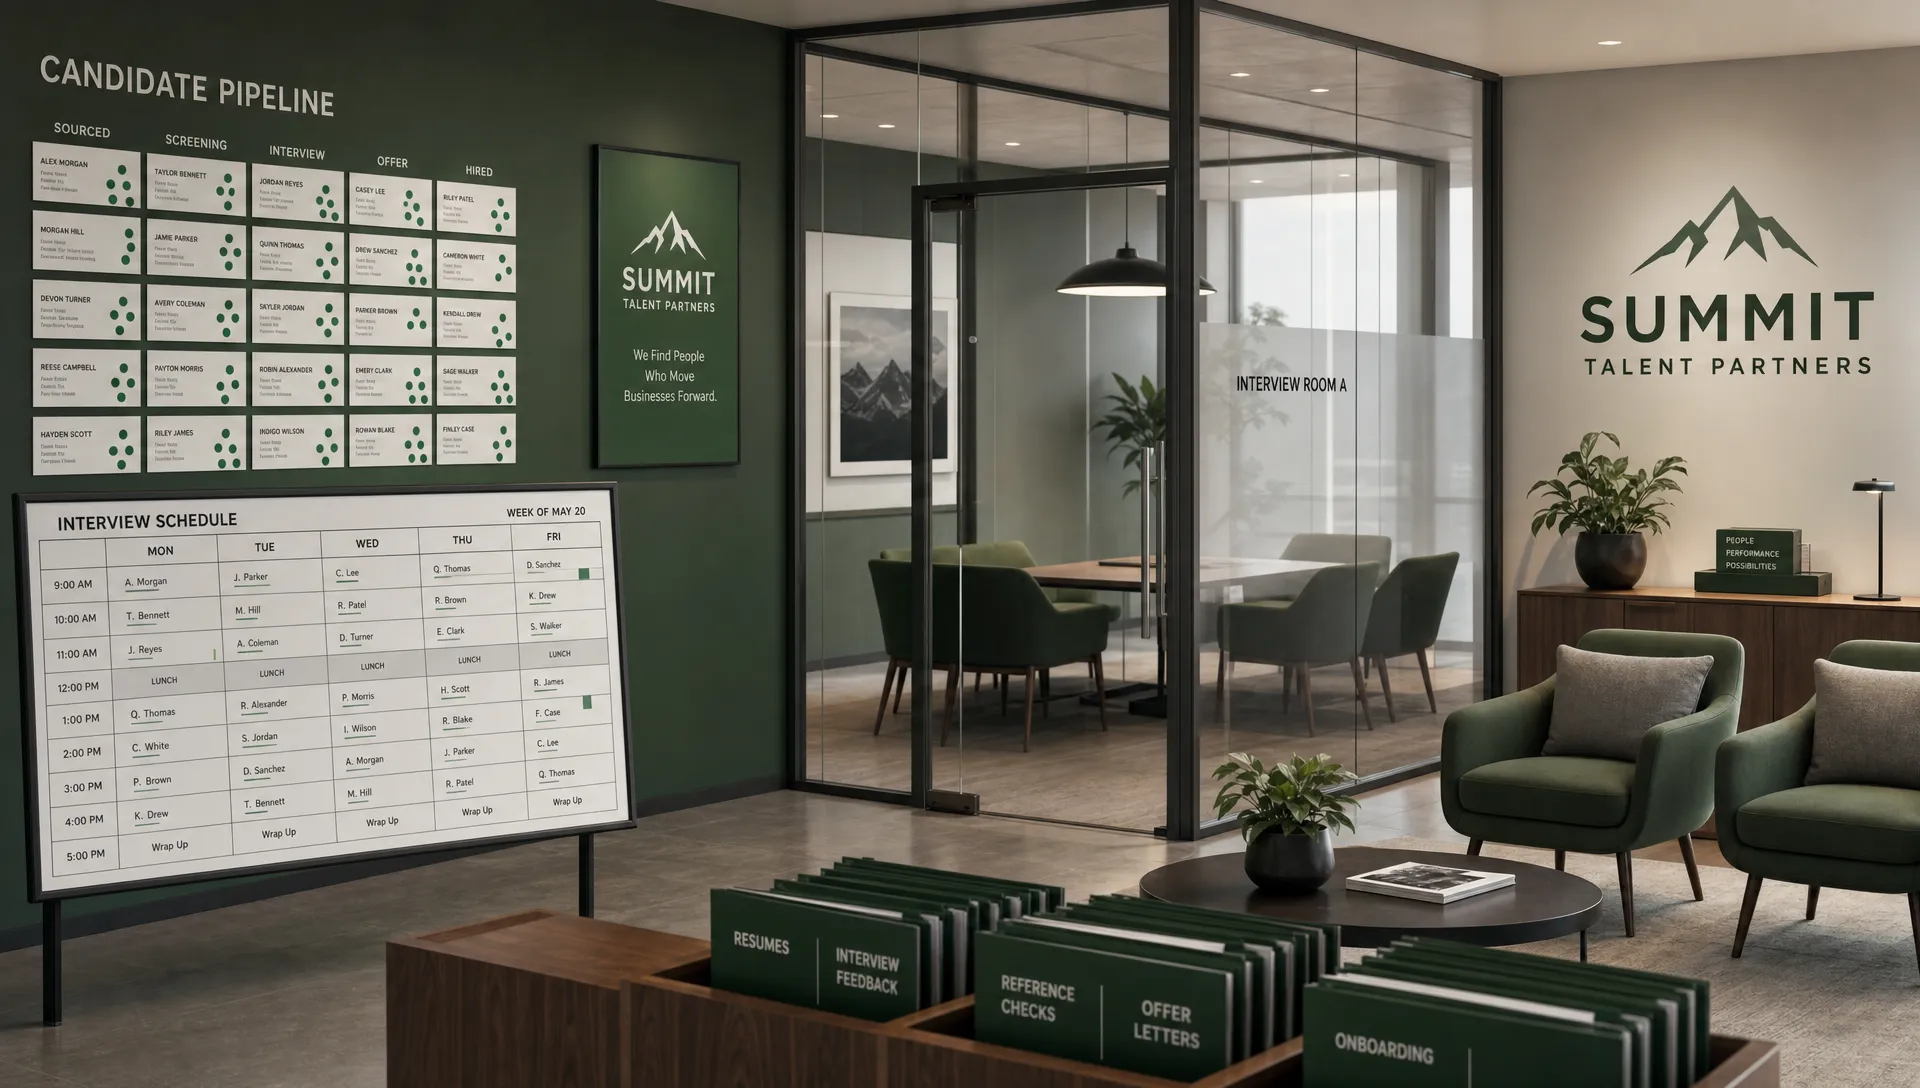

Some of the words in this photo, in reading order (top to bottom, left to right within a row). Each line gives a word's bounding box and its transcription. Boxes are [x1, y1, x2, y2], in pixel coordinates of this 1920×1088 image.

[40, 55, 207, 102] CANDIDATE
[220, 78, 334, 117] PIPELINE
[54, 122, 110, 138] SOURCED
[166, 134, 227, 150] SCREENING
[269, 145, 325, 160] INTERVIEW
[377, 156, 408, 168] OFFER
[466, 165, 493, 176] HIRED
[622, 266, 715, 295] SUMMIT
[623, 298, 661, 310] TALENT
[665, 300, 715, 312] PARTNERS
[1580, 291, 1875, 343] SUMMIT
[634, 349, 648, 361] We
[651, 350, 671, 362] Find
[674, 350, 704, 363] People
[1585, 358, 1693, 375] TALENT
[1712, 357, 1872, 375] PARTNERS
[645, 370, 667, 382] Who
[670, 371, 694, 382] Move
[1237, 376, 1300, 392] INTERVIEW
[1304, 377, 1336, 392] ROOM
[1340, 378, 1347, 392] A
[624, 390, 675, 402] Businesses
[678, 390, 717, 402] Forward.
[507, 508, 534, 517] WEEK
[537, 507, 549, 517] OF
[552, 507, 572, 516] MAY
[575, 506, 586, 515] 20
[58, 515, 150, 531] INTERVIEW
[156, 513, 237, 527] SCHEDULE
[453, 535, 472, 544] THU
[547, 532, 561, 541] FRI
[255, 542, 275, 552] TUE
[356, 539, 379, 548] WED
[148, 546, 174, 556] MON
[1726, 550, 1779, 558] PERFORMANCE
[433, 565, 441, 574] Q.
[444, 564, 471, 572] Thomas
[1726, 562, 1776, 570] POSSIBILITIES
[234, 574, 240, 582] J.
[244, 572, 268, 581] Parker
[336, 569, 344, 577] C.
[346, 568, 359, 577] Lee
[54, 580, 75, 590] 9:00
[77, 580, 92, 589] AM
[125, 578, 134, 586] A.
[137, 577, 167, 588] Morgan
[338, 601, 346, 609] R.
[348, 600, 366, 609] Patel
[127, 612, 135, 620] T.
[138, 611, 170, 620] Bennett
[236, 607, 246, 615] M.
[248, 606, 261, 614] Hill
[54, 614, 80, 624] 10:00
[82, 614, 96, 623] AM
[437, 627, 444, 635] E.
[446, 626, 465, 635] Clark
[340, 633, 348, 641] D.
[350, 632, 373, 641] Turner
[237, 640, 246, 648] A.
[248, 638, 278, 647] Coleman
[57, 650, 80, 659] 11:00
[82, 648, 97, 658] AM
[128, 646, 135, 654] J.
[138, 645, 162, 656] Reyes
[458, 656, 481, 664] LUNCH
[361, 662, 385, 671] LUNCH
[260, 669, 284, 678] LUNCH
[152, 676, 178, 685] LUNCH
[58, 683, 83, 692] 12:00
[85, 682, 99, 691] PM
[441, 686, 449, 694] H.
[451, 685, 470, 693] Scott
[342, 693, 349, 701] P.
[351, 692, 374, 700] Morris
[130, 710, 140, 720] Q.
[143, 708, 176, 717] Thomas
[544, 708, 561, 716] Case
[62, 715, 84, 724] 1:00
[86, 714, 100, 722] PM
[242, 734, 249, 742] S.
[252, 732, 278, 742] Jordan
[63, 748, 84, 758] 2:00
[86, 747, 101, 756] PM
[132, 744, 141, 752] C.
[145, 742, 169, 751] White
[254, 766, 286, 774] Sanchez
[134, 778, 142, 786] P.
[146, 776, 172, 785] Brown
[64, 783, 86, 793] 3:00
[88, 782, 102, 791] PM
[244, 800, 252, 809] T.
[255, 798, 285, 808] Bennett
[553, 798, 572, 806] Wrap
[573, 796, 582, 805] Up
[65, 816, 86, 826] 4:00
[88, 815, 104, 824] PM
[135, 812, 143, 820] K.
[147, 810, 169, 819] Drew
[366, 818, 386, 827] Wrap
[387, 816, 399, 825] Up
[262, 830, 282, 840] Wrap
[284, 828, 296, 838] Up
[152, 842, 173, 853] Wrap
[175, 841, 188, 851] Up
[67, 851, 88, 861] 5:00
[90, 850, 105, 859] PM
[734, 931, 790, 954] RESUMES
[836, 948, 900, 972] INTERVIEW
[836, 970, 898, 996] FEEDBACK
[1001, 974, 1075, 1003] REFERENCE
[1001, 998, 1056, 1023] CHECKS
[1141, 999, 1192, 1025] OFFER
[1134, 1022, 1200, 1050] LETTERS
[1335, 1031, 1434, 1065] ONBOARDING
